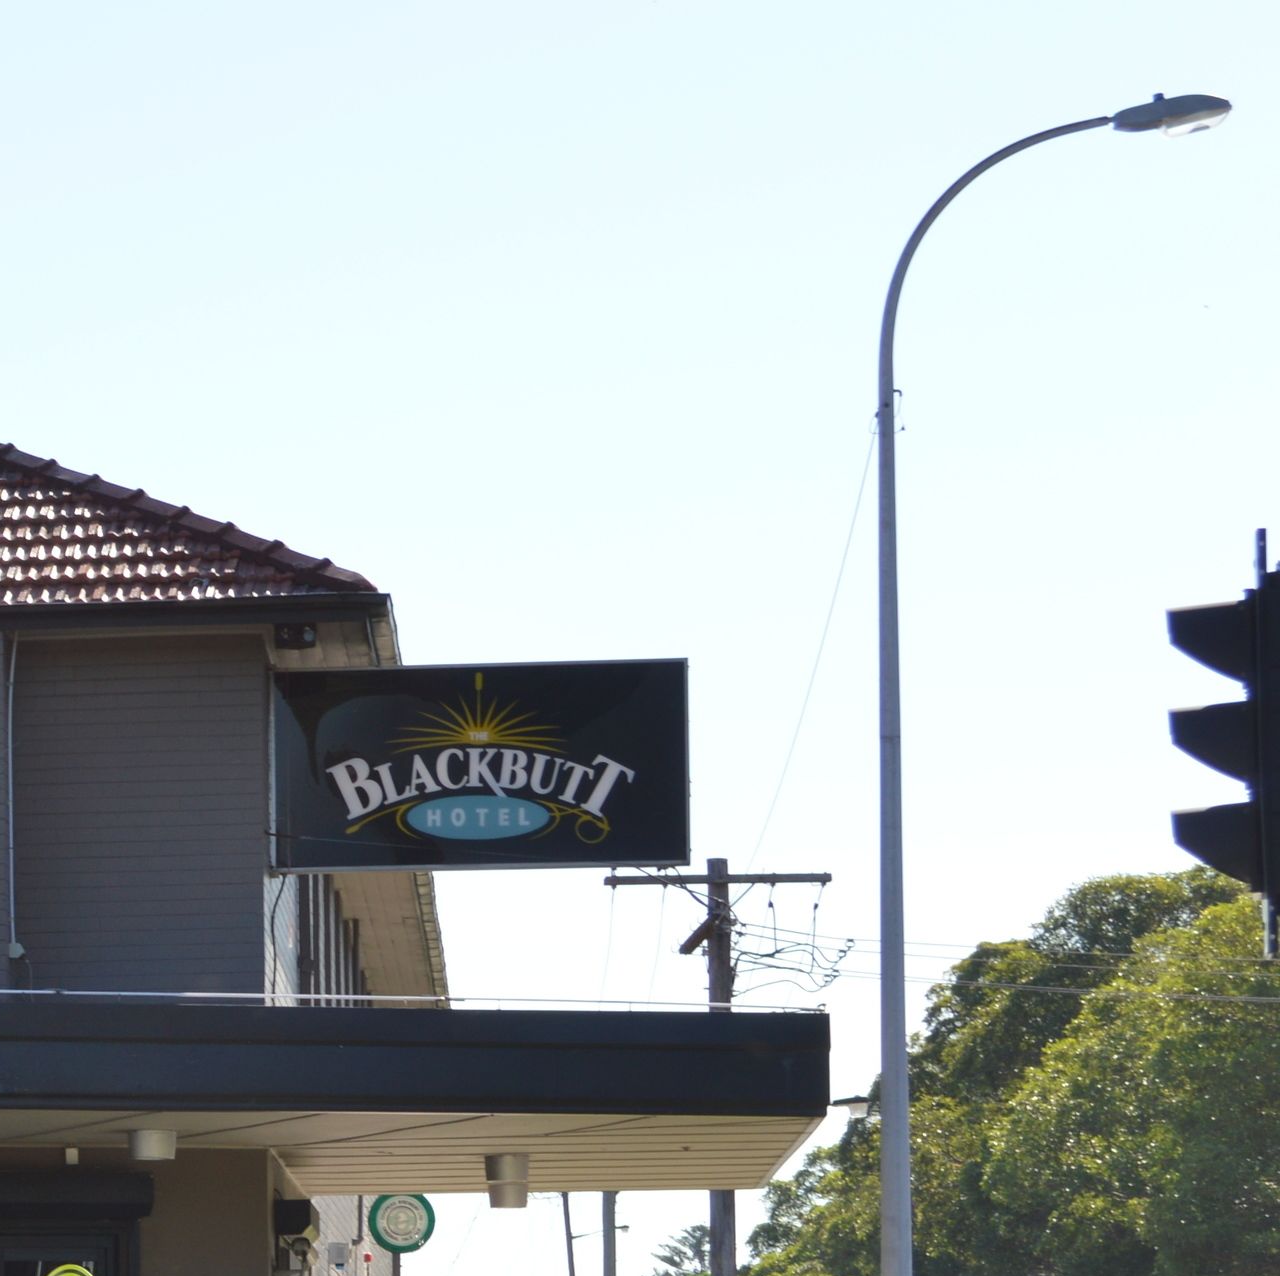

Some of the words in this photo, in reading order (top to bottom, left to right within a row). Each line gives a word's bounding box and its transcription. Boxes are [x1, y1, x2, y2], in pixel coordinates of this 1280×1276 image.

[468, 731, 490, 742] THE
[326, 748, 635, 821] BLACKBUTT
[426, 807, 531, 828] HOTEL
